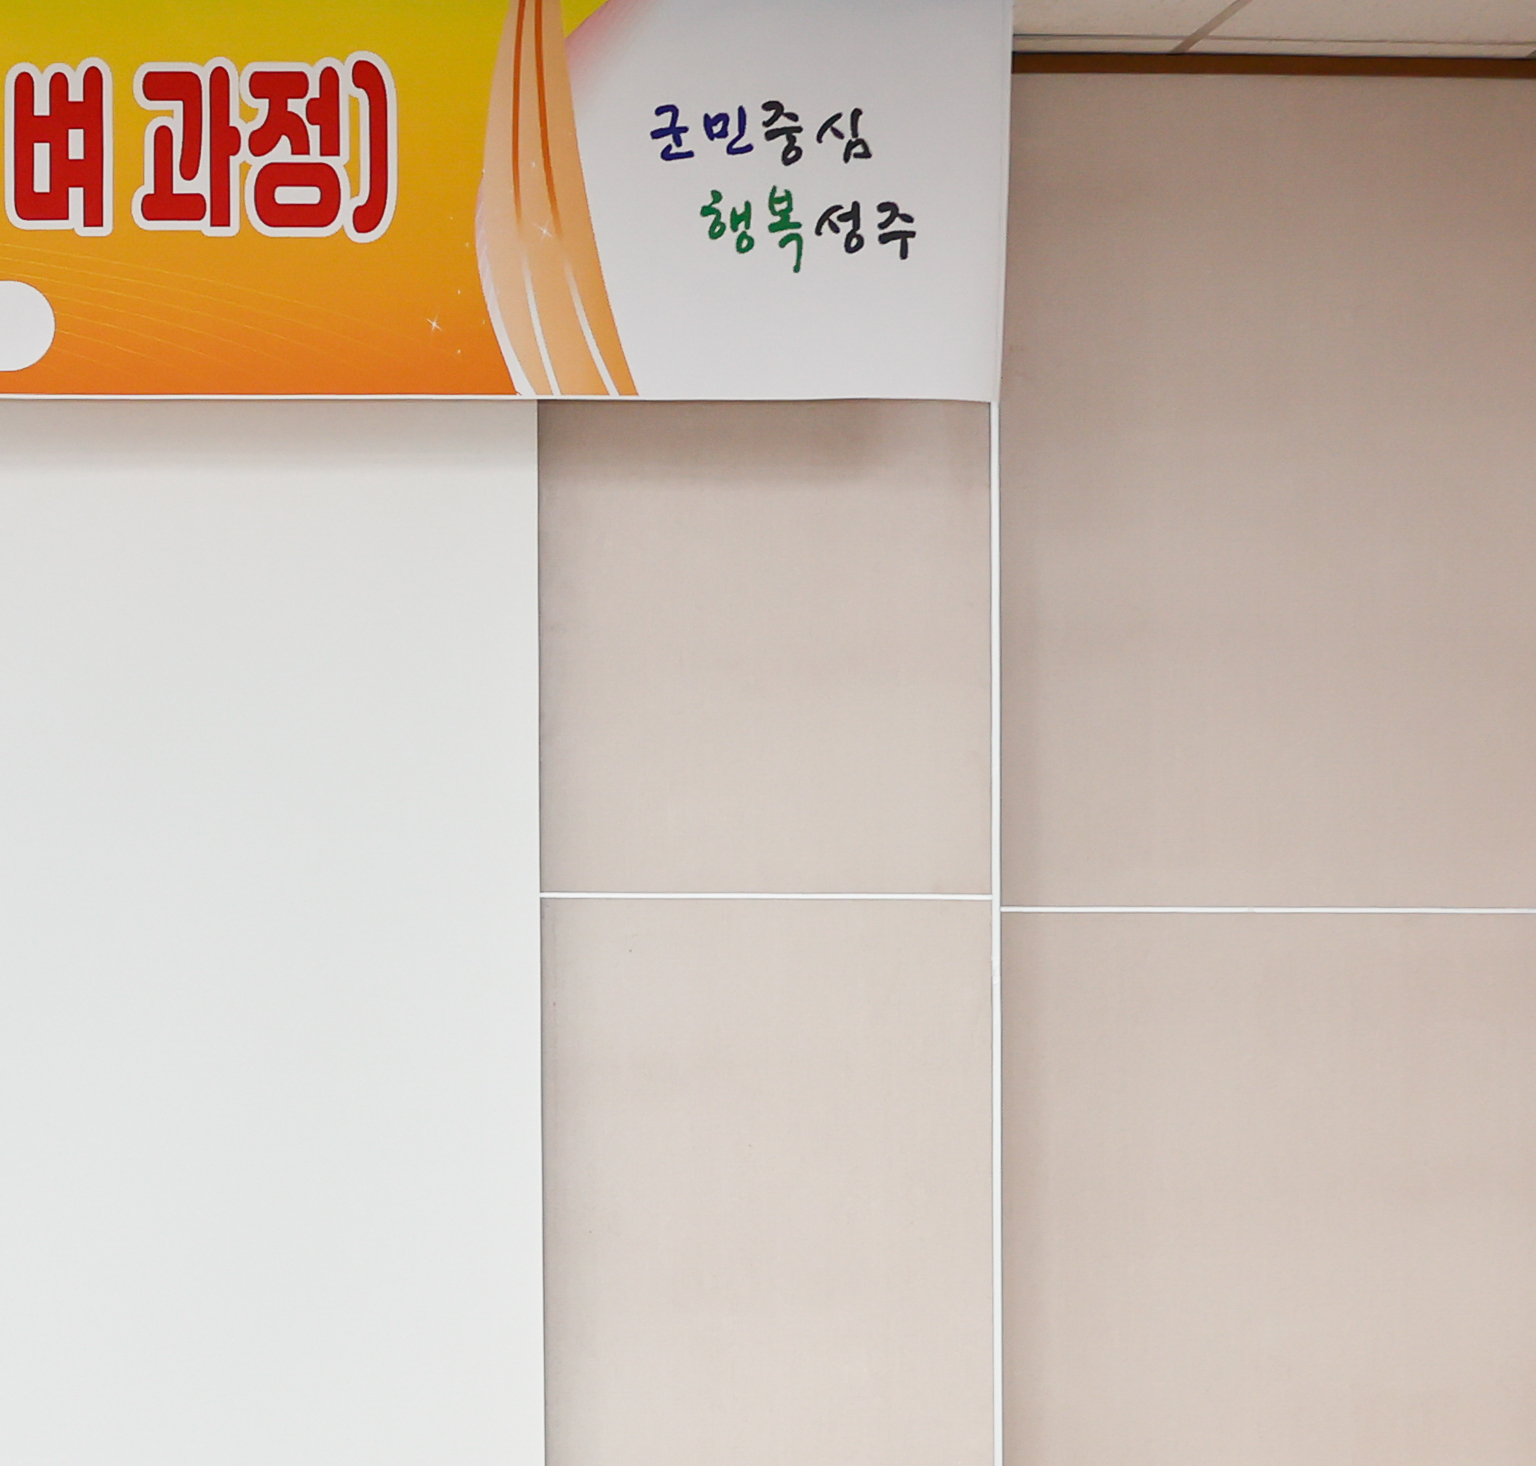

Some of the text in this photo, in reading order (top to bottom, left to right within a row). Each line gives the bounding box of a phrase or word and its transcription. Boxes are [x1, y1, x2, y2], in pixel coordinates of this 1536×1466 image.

[12, 64, 106, 230] 벼
[140, 58, 391, 236] 과정)
[649, 99, 873, 167] 군민중심
[699, 184, 917, 274] 행복성주
